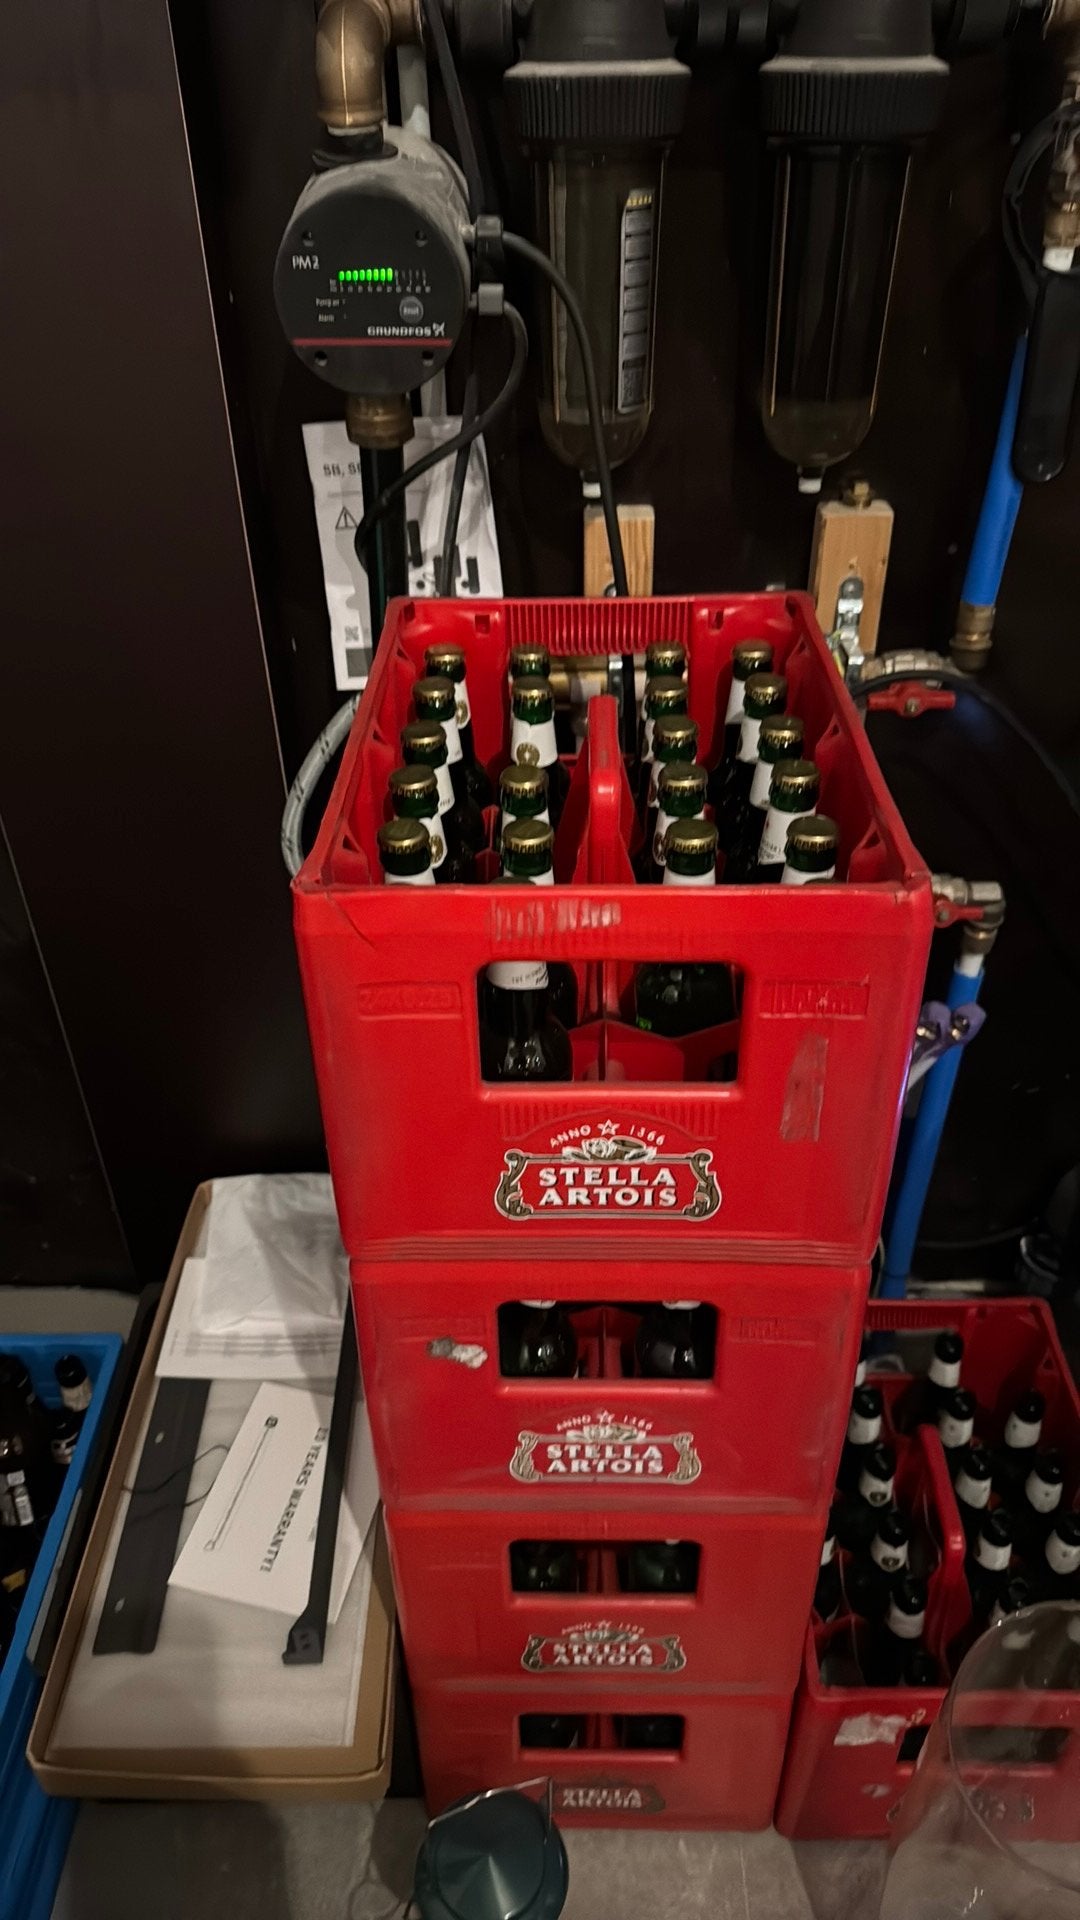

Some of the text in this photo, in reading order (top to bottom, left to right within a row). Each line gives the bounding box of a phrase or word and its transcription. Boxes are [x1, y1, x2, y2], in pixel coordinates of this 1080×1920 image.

[292, 255, 320, 270] PM2
[367, 325, 432, 336] GRUNDFOS
[550, 1125, 665, 1148] ANNO 1366
[539, 1167, 676, 1187] STELLA
[539, 1187, 677, 1207] ARTOIS
[547, 1444, 662, 1460] STELLA
[296, 1444, 322, 1486] YEARS
[548, 1459, 663, 1474] ARTOIS
